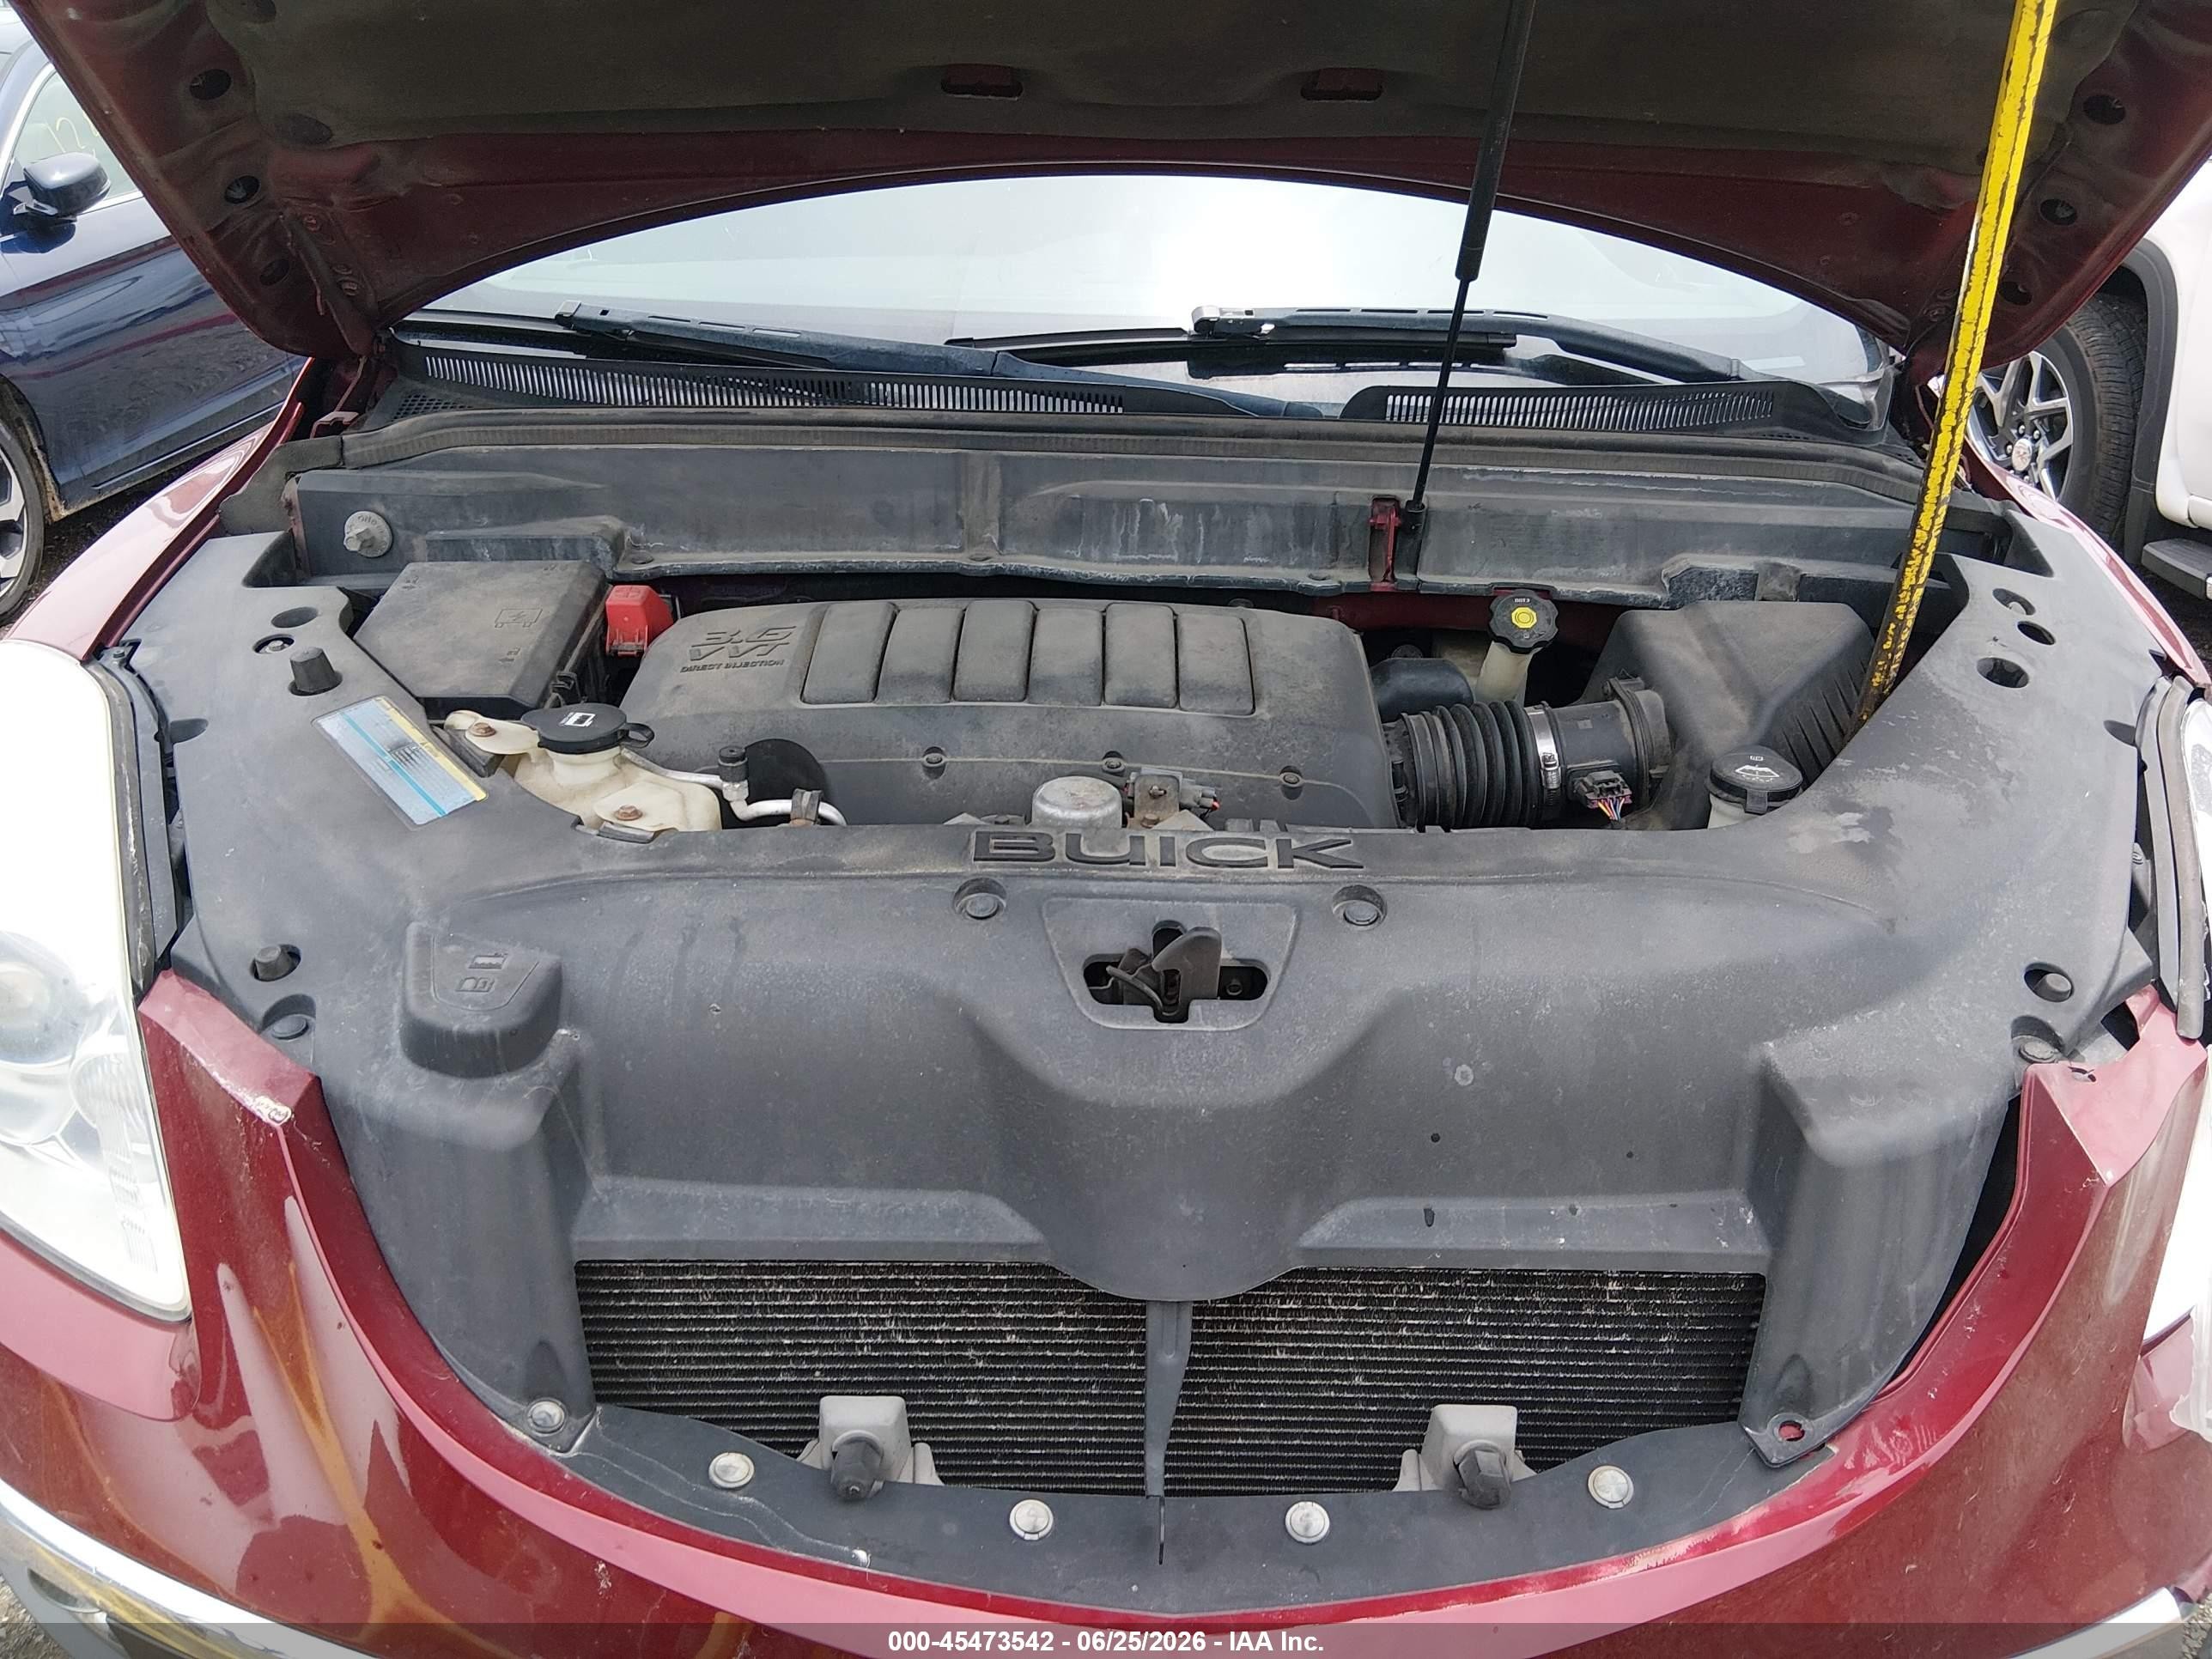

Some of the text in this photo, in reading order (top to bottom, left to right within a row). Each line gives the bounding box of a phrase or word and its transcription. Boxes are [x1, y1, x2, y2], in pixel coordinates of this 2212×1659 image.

[691, 626, 797, 647] 3.6
[680, 659, 785, 673] DIRECT INJECTION
[973, 830, 1364, 869] BUICK
